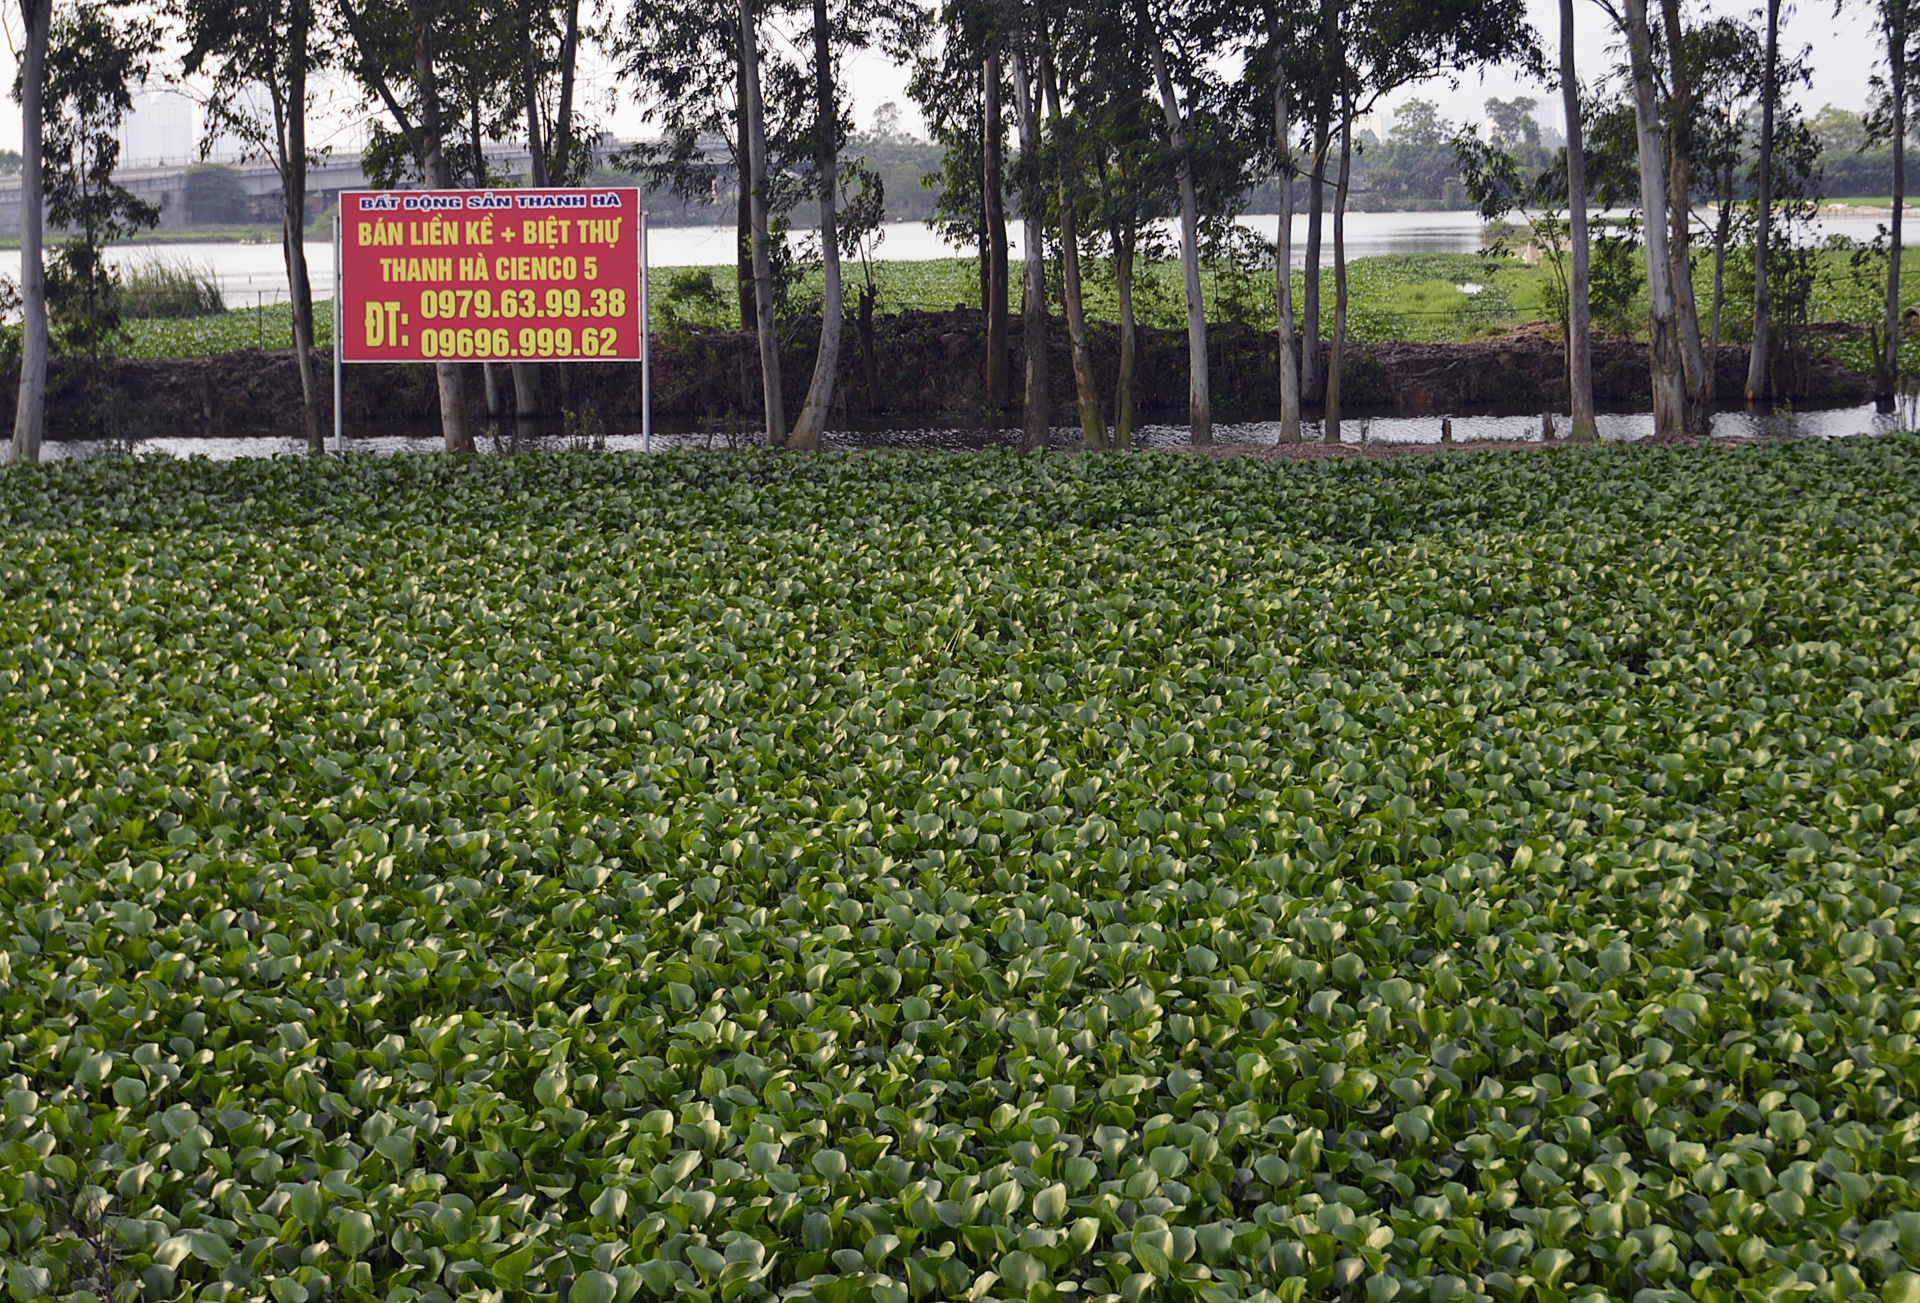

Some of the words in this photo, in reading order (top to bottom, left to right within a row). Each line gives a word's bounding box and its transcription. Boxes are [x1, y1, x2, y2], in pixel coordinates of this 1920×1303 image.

[403, 197, 463, 212] ĐỘNG
[516, 195, 587, 209] THANH
[590, 192, 622, 208] HÀ
[358, 217, 403, 246] BÁN
[410, 213, 459, 246] LIỀN
[465, 213, 494, 245] KỀ
[501, 227, 516, 243] +
[523, 215, 571, 249] BIỆT
[576, 217, 622, 248] THỰ
[380, 257, 453, 282] THANH
[459, 253, 489, 281] HÀ
[496, 256, 577, 281] CIENCO
[584, 256, 598, 281] 5
[420, 288, 626, 319] 0979.63.99.38
[365, 301, 409, 347] ĐT:
[420, 327, 618, 358] 09696.999.62
